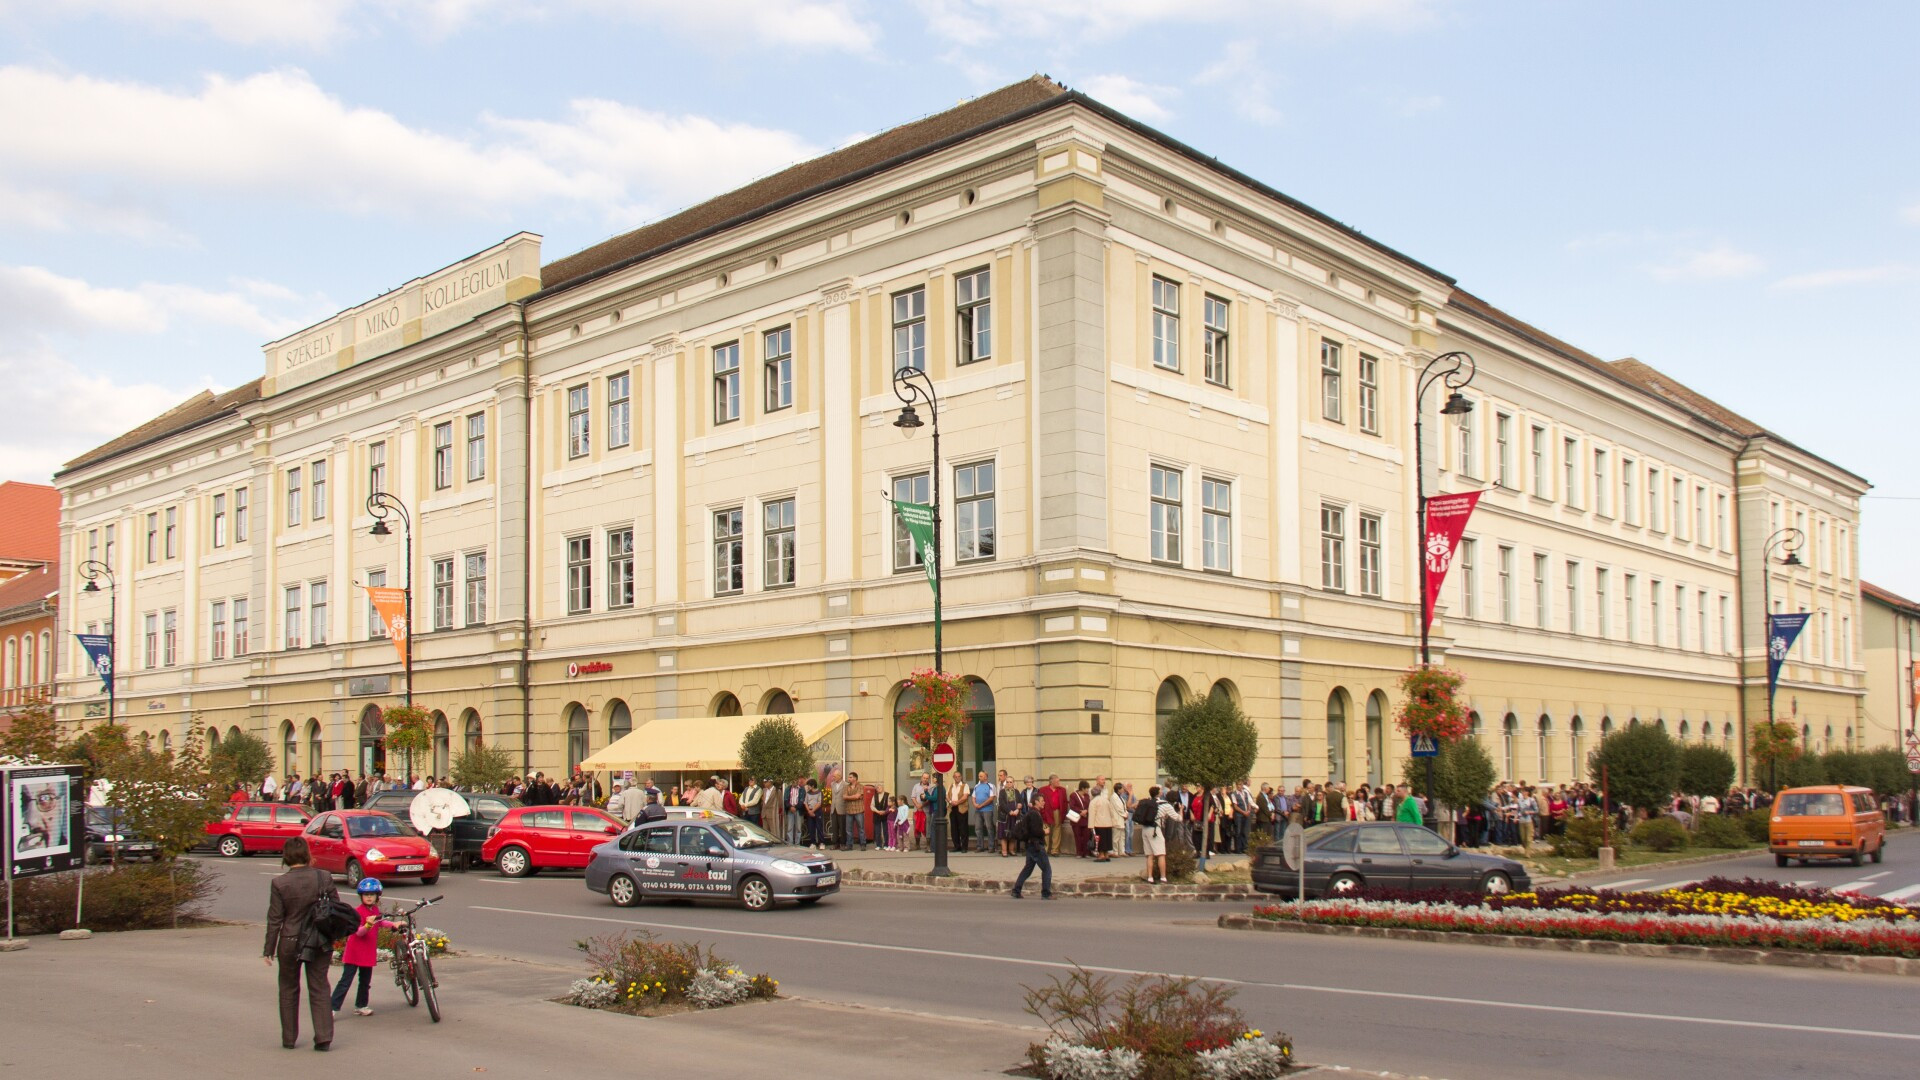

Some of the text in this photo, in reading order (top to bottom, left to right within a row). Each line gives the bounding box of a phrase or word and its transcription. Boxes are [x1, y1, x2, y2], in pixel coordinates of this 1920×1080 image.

[286, 259, 511, 369] SZÉKELY MIKÓ KOLLÉGIUM
[1909, 761, 1920, 770] 30
